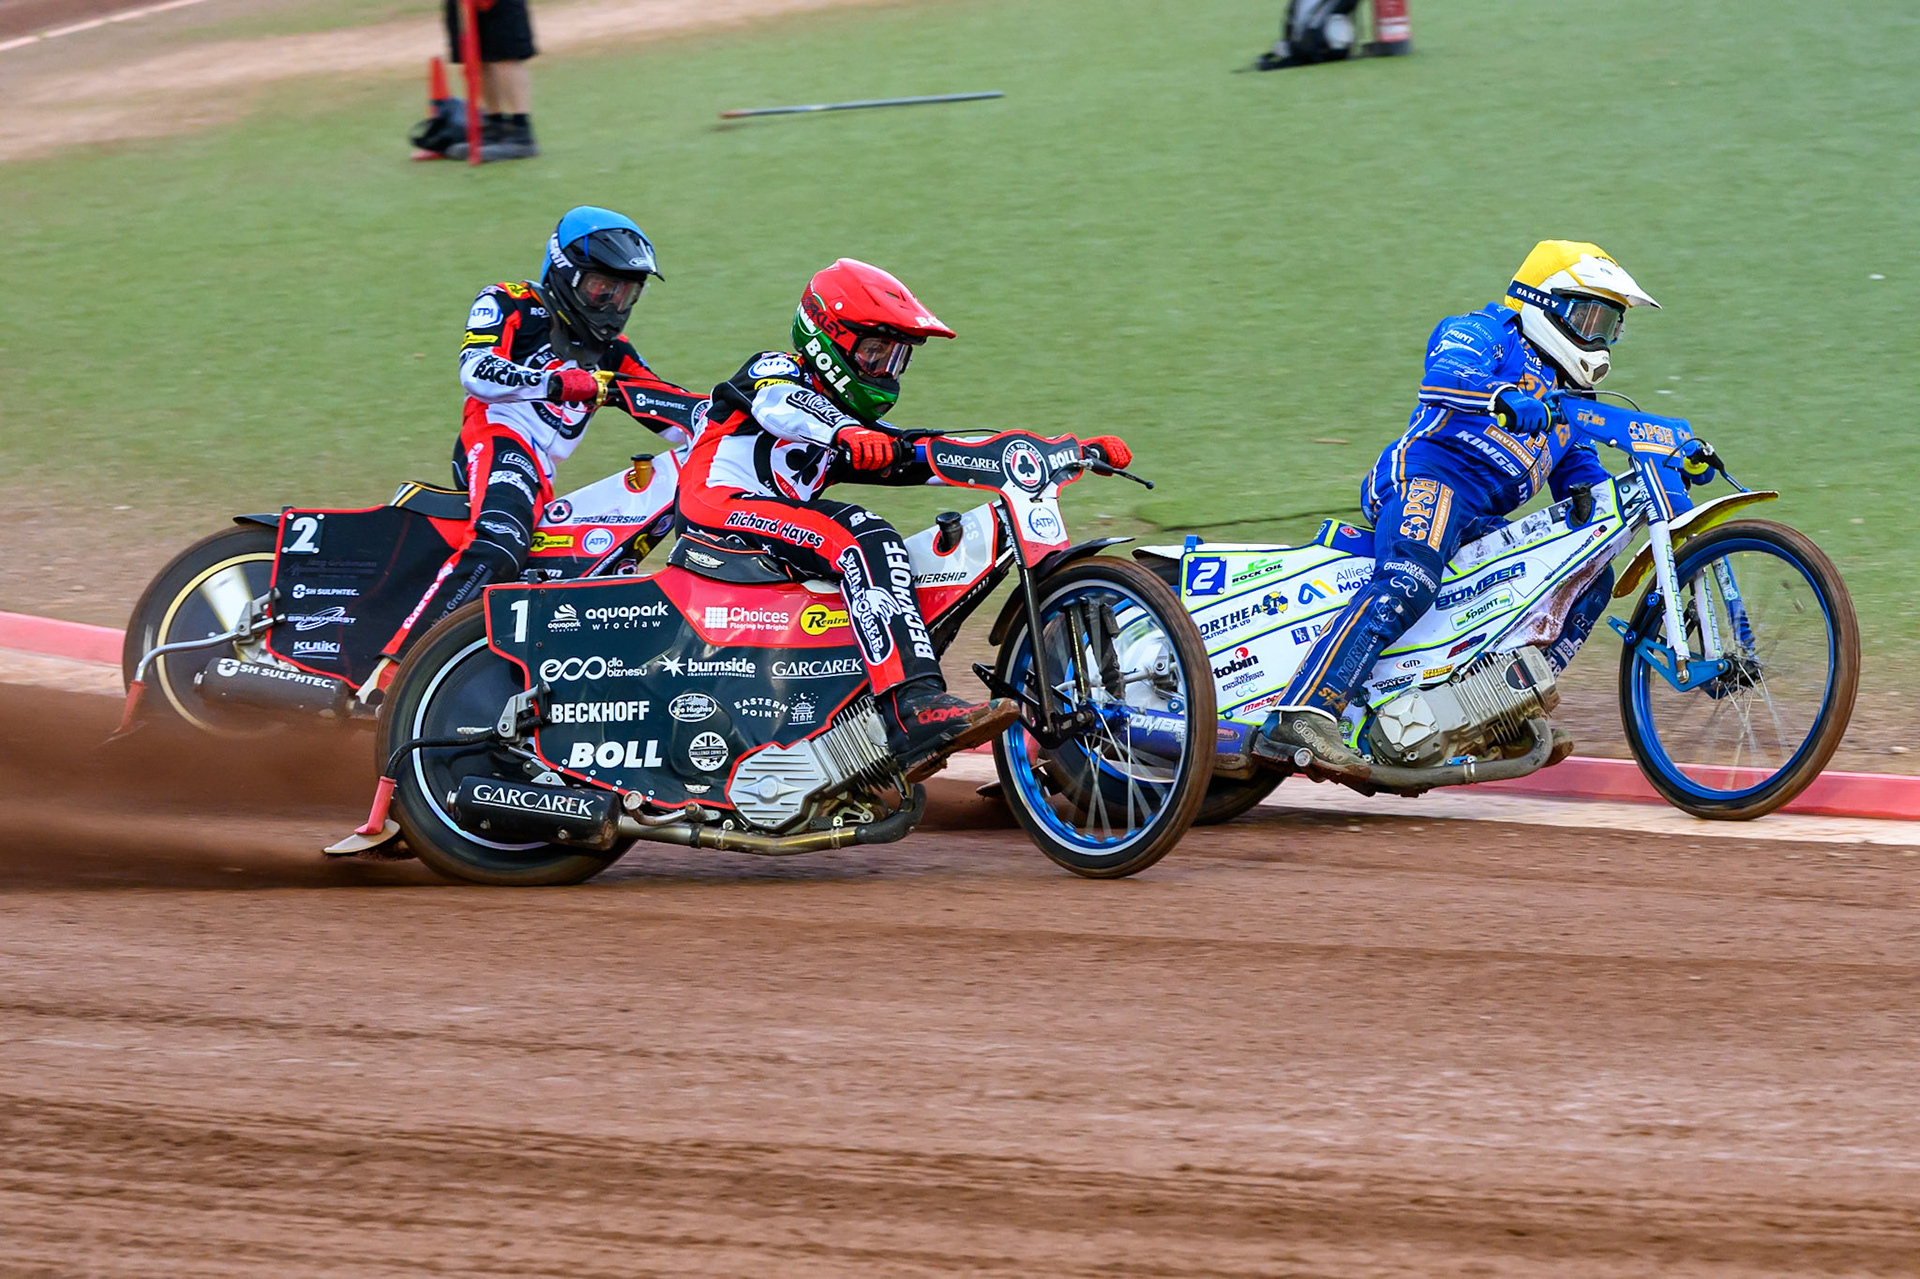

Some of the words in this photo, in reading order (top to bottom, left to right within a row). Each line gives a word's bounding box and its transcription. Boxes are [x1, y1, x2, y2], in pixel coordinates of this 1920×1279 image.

[1516, 287, 1559, 309] OAKLEY
[1642, 423, 1676, 446] PSH
[936, 452, 1000, 471] GARCAREK
[1048, 449, 1079, 470] BOLL
[1455, 430, 1521, 477] KINGS
[1403, 477, 1440, 518] PSH
[724, 511, 780, 534] Richard
[779, 521, 825, 549] Hayes
[1035, 518, 1056, 528] ATPI
[289, 516, 318, 552] 2
[588, 537, 608, 546] ATPI
[913, 572, 967, 585] MIERSHIP
[1192, 562, 1220, 590] 2
[1232, 569, 1262, 583] ROCK
[1264, 563, 1283, 572] OIL
[1336, 563, 1374, 582] Allied
[1384, 562, 1437, 593] ENGINEERING
[447, 563, 486, 611] Grohmann
[1435, 561, 1526, 610] BOMBER
[883, 541, 935, 660] BECKHOFF
[1465, 598, 1499, 619] SPRINT
[510, 600, 528, 642] 1
[585, 601, 669, 622] aquapark
[730, 607, 789, 624] Choices
[807, 611, 850, 628] Rentru
[1200, 594, 1281, 635] ORTHEAST
[1240, 618, 1251, 626] LTD
[730, 622, 756, 630] Flooring
[240, 664, 259, 674] SH
[607, 657, 623, 667] dla
[607, 667, 648, 677] biznesu
[687, 658, 756, 673] burnside
[772, 658, 863, 676] GARCAREK
[1213, 655, 1259, 678] tobin
[1403, 660, 1420, 668] GM
[551, 701, 650, 724] BECKHOFF
[734, 698, 789, 712] EASTERN
[742, 710, 780, 718] POINT
[1293, 720, 1348, 762] daytona
[568, 740, 662, 769] BOLL
[473, 785, 594, 816] GARCAREK
